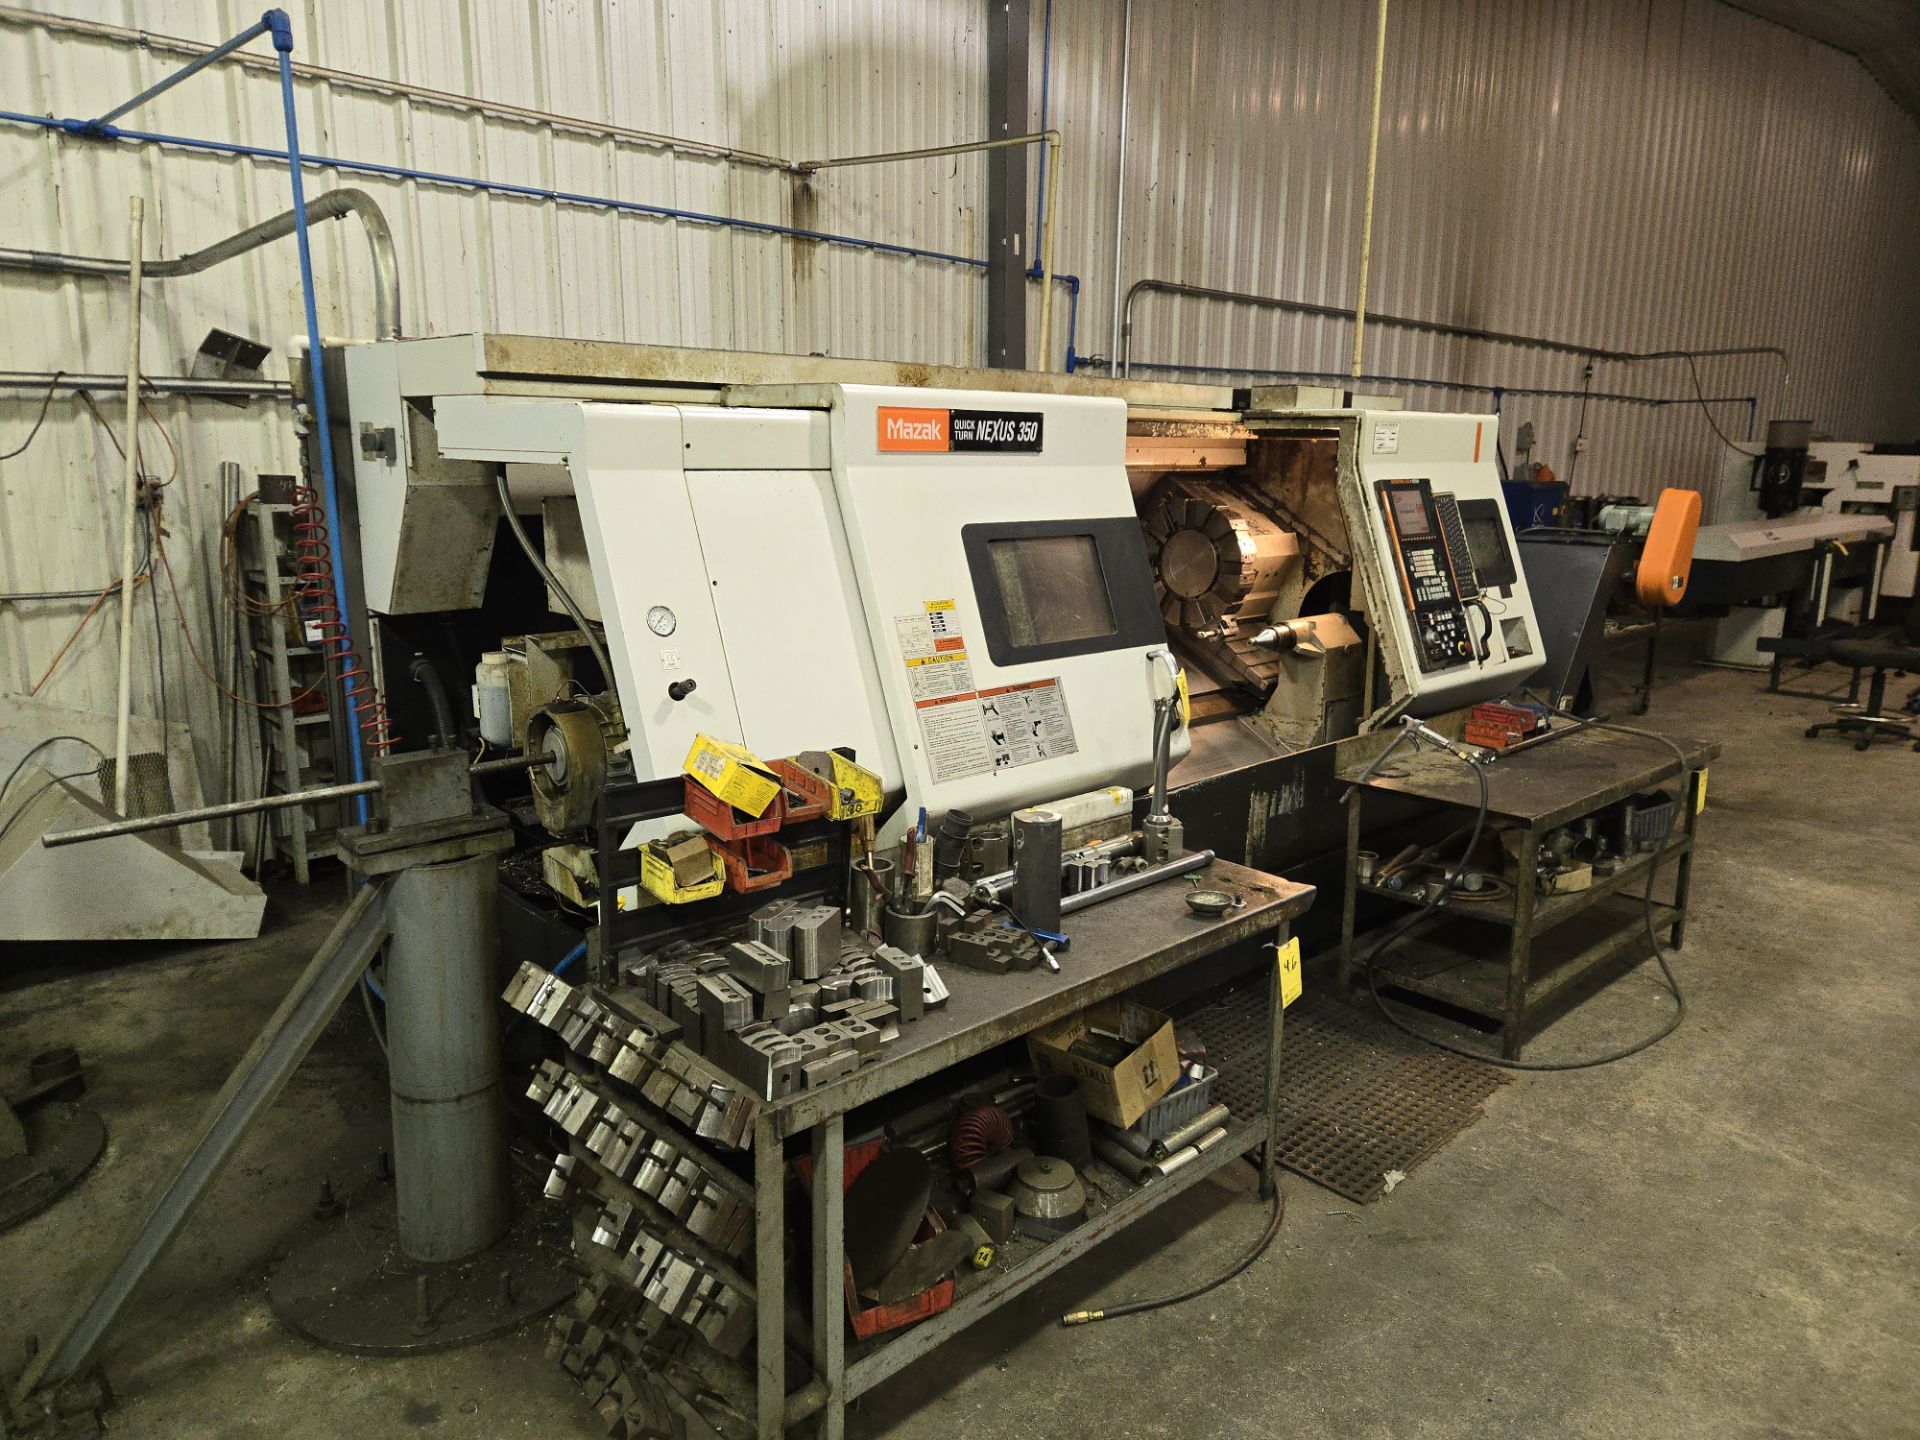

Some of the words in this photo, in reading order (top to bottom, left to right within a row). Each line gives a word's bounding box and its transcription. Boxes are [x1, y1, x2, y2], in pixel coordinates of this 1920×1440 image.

[887, 418, 942, 441] Mazak
[954, 419, 976, 430] QUICK
[976, 418, 1015, 443] NEXUS
[1017, 421, 1039, 442] 350
[954, 430, 974, 441] TURN
[927, 655, 954, 664] CAUTION
[1283, 954, 1298, 973] 46
